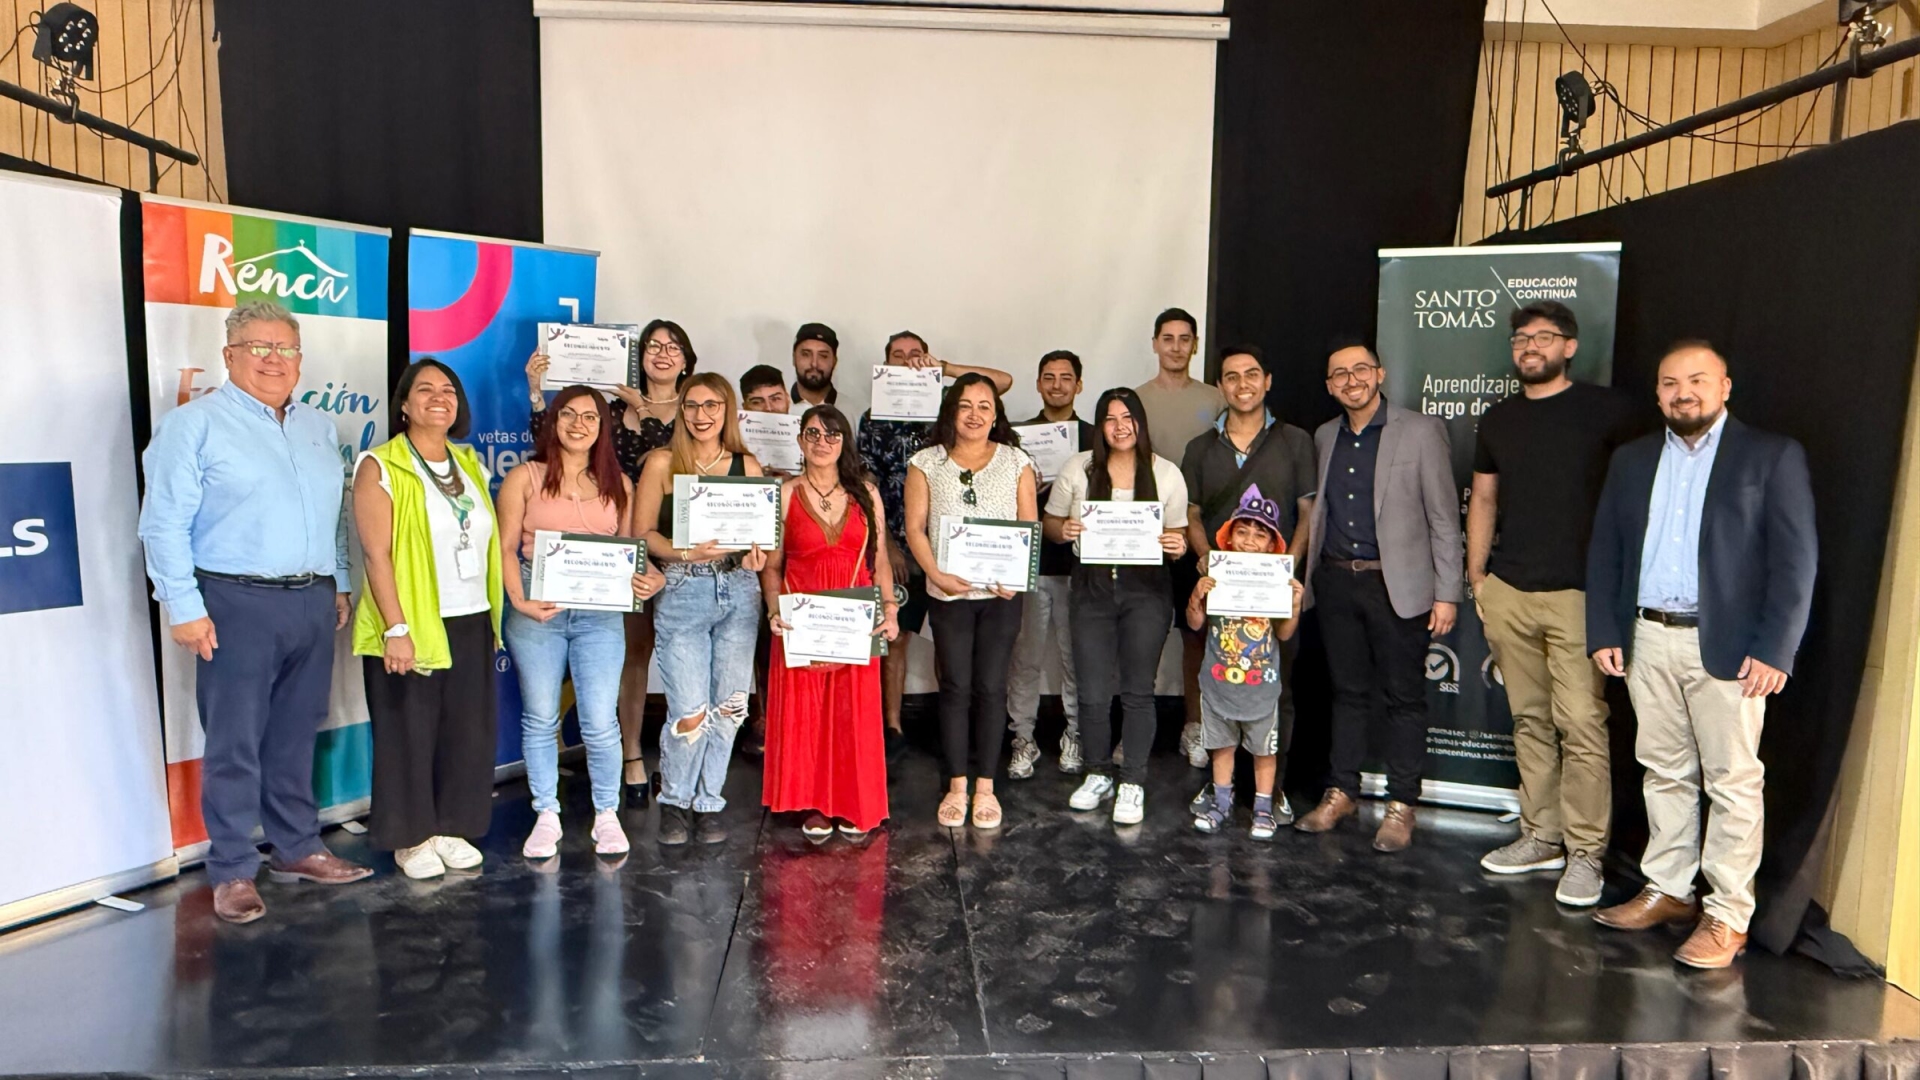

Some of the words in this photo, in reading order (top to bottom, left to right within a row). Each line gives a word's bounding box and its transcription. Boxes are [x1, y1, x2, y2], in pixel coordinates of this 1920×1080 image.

[199, 233, 348, 303] Renca
[1507, 276, 1577, 288] EDUCACIÓN
[1415, 289, 1497, 308] SANTO
[1516, 289, 1577, 299] CONTINUA
[1414, 306, 1496, 328] TOMÁS
[1423, 374, 1520, 398] Aprendizaje
[1422, 396, 1465, 420] largo
[478, 429, 517, 443] vetas
[1211, 663, 1277, 686] COCO
[1439, 681, 1459, 694] SGS
